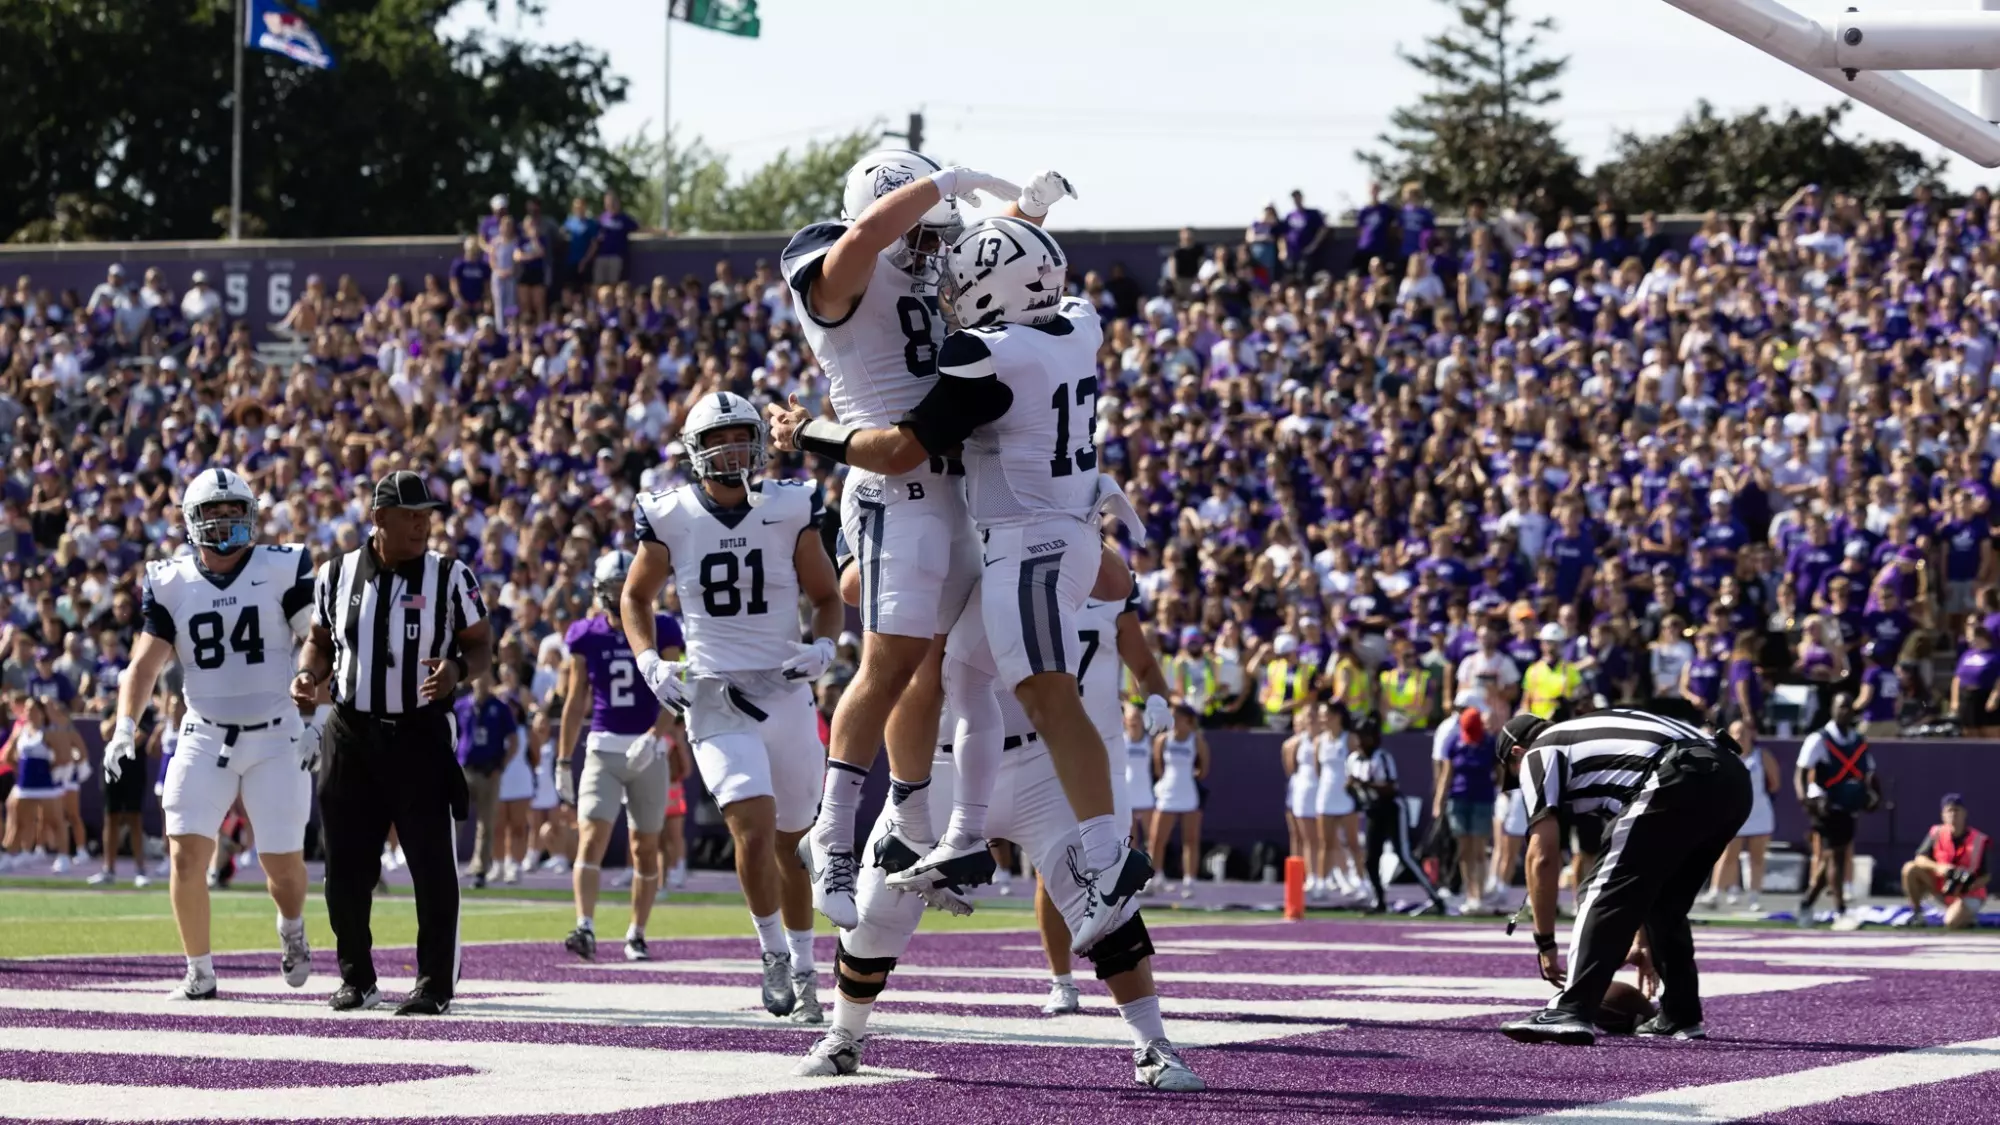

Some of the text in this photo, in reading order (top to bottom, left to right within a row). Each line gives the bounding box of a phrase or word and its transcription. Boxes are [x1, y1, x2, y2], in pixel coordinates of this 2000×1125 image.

[975, 238, 1002, 267] 13
[225, 273, 248, 315] 5
[268, 273, 292, 315] 6
[1050, 375, 1097, 478] 13
[906, 482, 926, 500] B
[719, 536, 748, 550] BUTLER
[1026, 538, 1069, 555] BUTLER
[700, 548, 769, 618] 81
[212, 596, 238, 609] BUTLER
[351, 594, 362, 606] S
[188, 605, 266, 670] 84
[405, 623, 419, 640] U
[608, 659, 636, 708] 2
